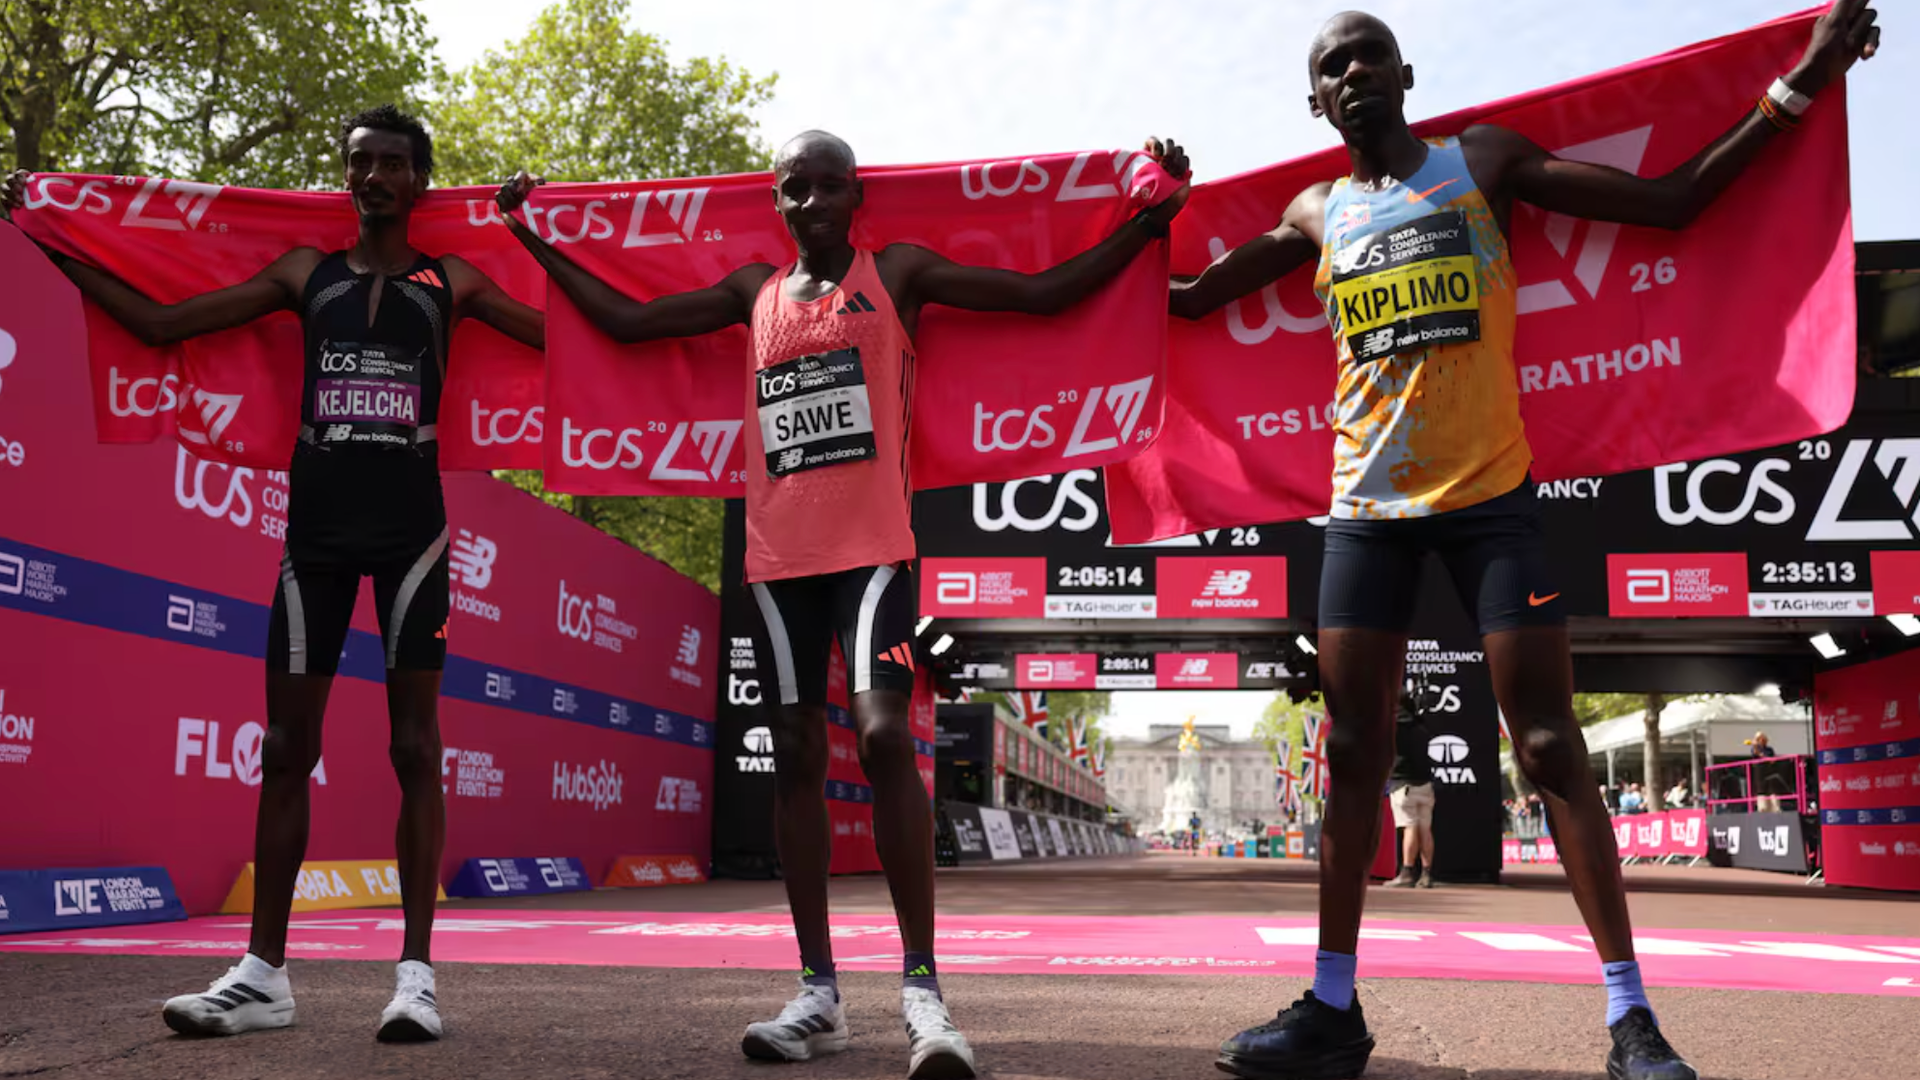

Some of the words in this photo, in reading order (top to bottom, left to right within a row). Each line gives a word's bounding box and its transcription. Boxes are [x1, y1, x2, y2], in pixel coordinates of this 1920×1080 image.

[523, 201, 614, 245] tcs
[1388, 227, 1418, 243] TATA
[1389, 229, 1459, 252] CONSULTANCY
[1390, 243, 1435, 262] SERVICES
[1630, 257, 1677, 293] 26
[1342, 271, 1470, 327] KIPLIMO
[1396, 334, 1419, 346] new
[1420, 326, 1469, 340] balance
[321, 350, 357, 372] tcs
[361, 350, 385, 359] TATA
[109, 366, 179, 417] tcs
[761, 372, 796, 399] tcs
[318, 390, 415, 421] KEJELCHA
[471, 399, 544, 446] tcs
[775, 401, 854, 442] SAWE
[972, 401, 1056, 452] tcs
[1058, 389, 1078, 404] 20
[1237, 408, 1302, 440] TCS
[371, 433, 408, 445] balance
[562, 417, 643, 470] tcs
[648, 421, 667, 433] 20
[825, 447, 866, 460] balance
[1653, 458, 1796, 525] tcs
[1799, 440, 1831, 461] 20
[1230, 524, 1258, 546] 26
[1059, 567, 1144, 587] 2:05:14
[1674, 569, 1711, 578] ABBOTT
[1674, 577, 1709, 586] WORLD
[1762, 562, 1856, 583] 2:35:13
[1674, 585, 1729, 595] MARATHON
[1674, 594, 1713, 602] MAJORS
[456, 590, 501, 622] balance
[558, 580, 592, 641] tcs
[1191, 598, 1213, 607] new
[1214, 597, 1259, 608] balance
[730, 637, 753, 648] TAT
[1407, 640, 1440, 650] TATA
[1102, 658, 1149, 671] 2:05:14
[1405, 652, 1485, 662] CONSULTANCY
[728, 673, 762, 705] tc
[457, 749, 493, 768] LONDON
[735, 757, 776, 772] TAT
[457, 764, 504, 784] MARATHON
[1431, 767, 1477, 783] ATA
[456, 780, 487, 797] EVENTS
[552, 759, 623, 811] HubSpot
[101, 877, 143, 889] LONDON
[105, 887, 161, 899] MARATHON
[109, 899, 147, 912] EVENTS
